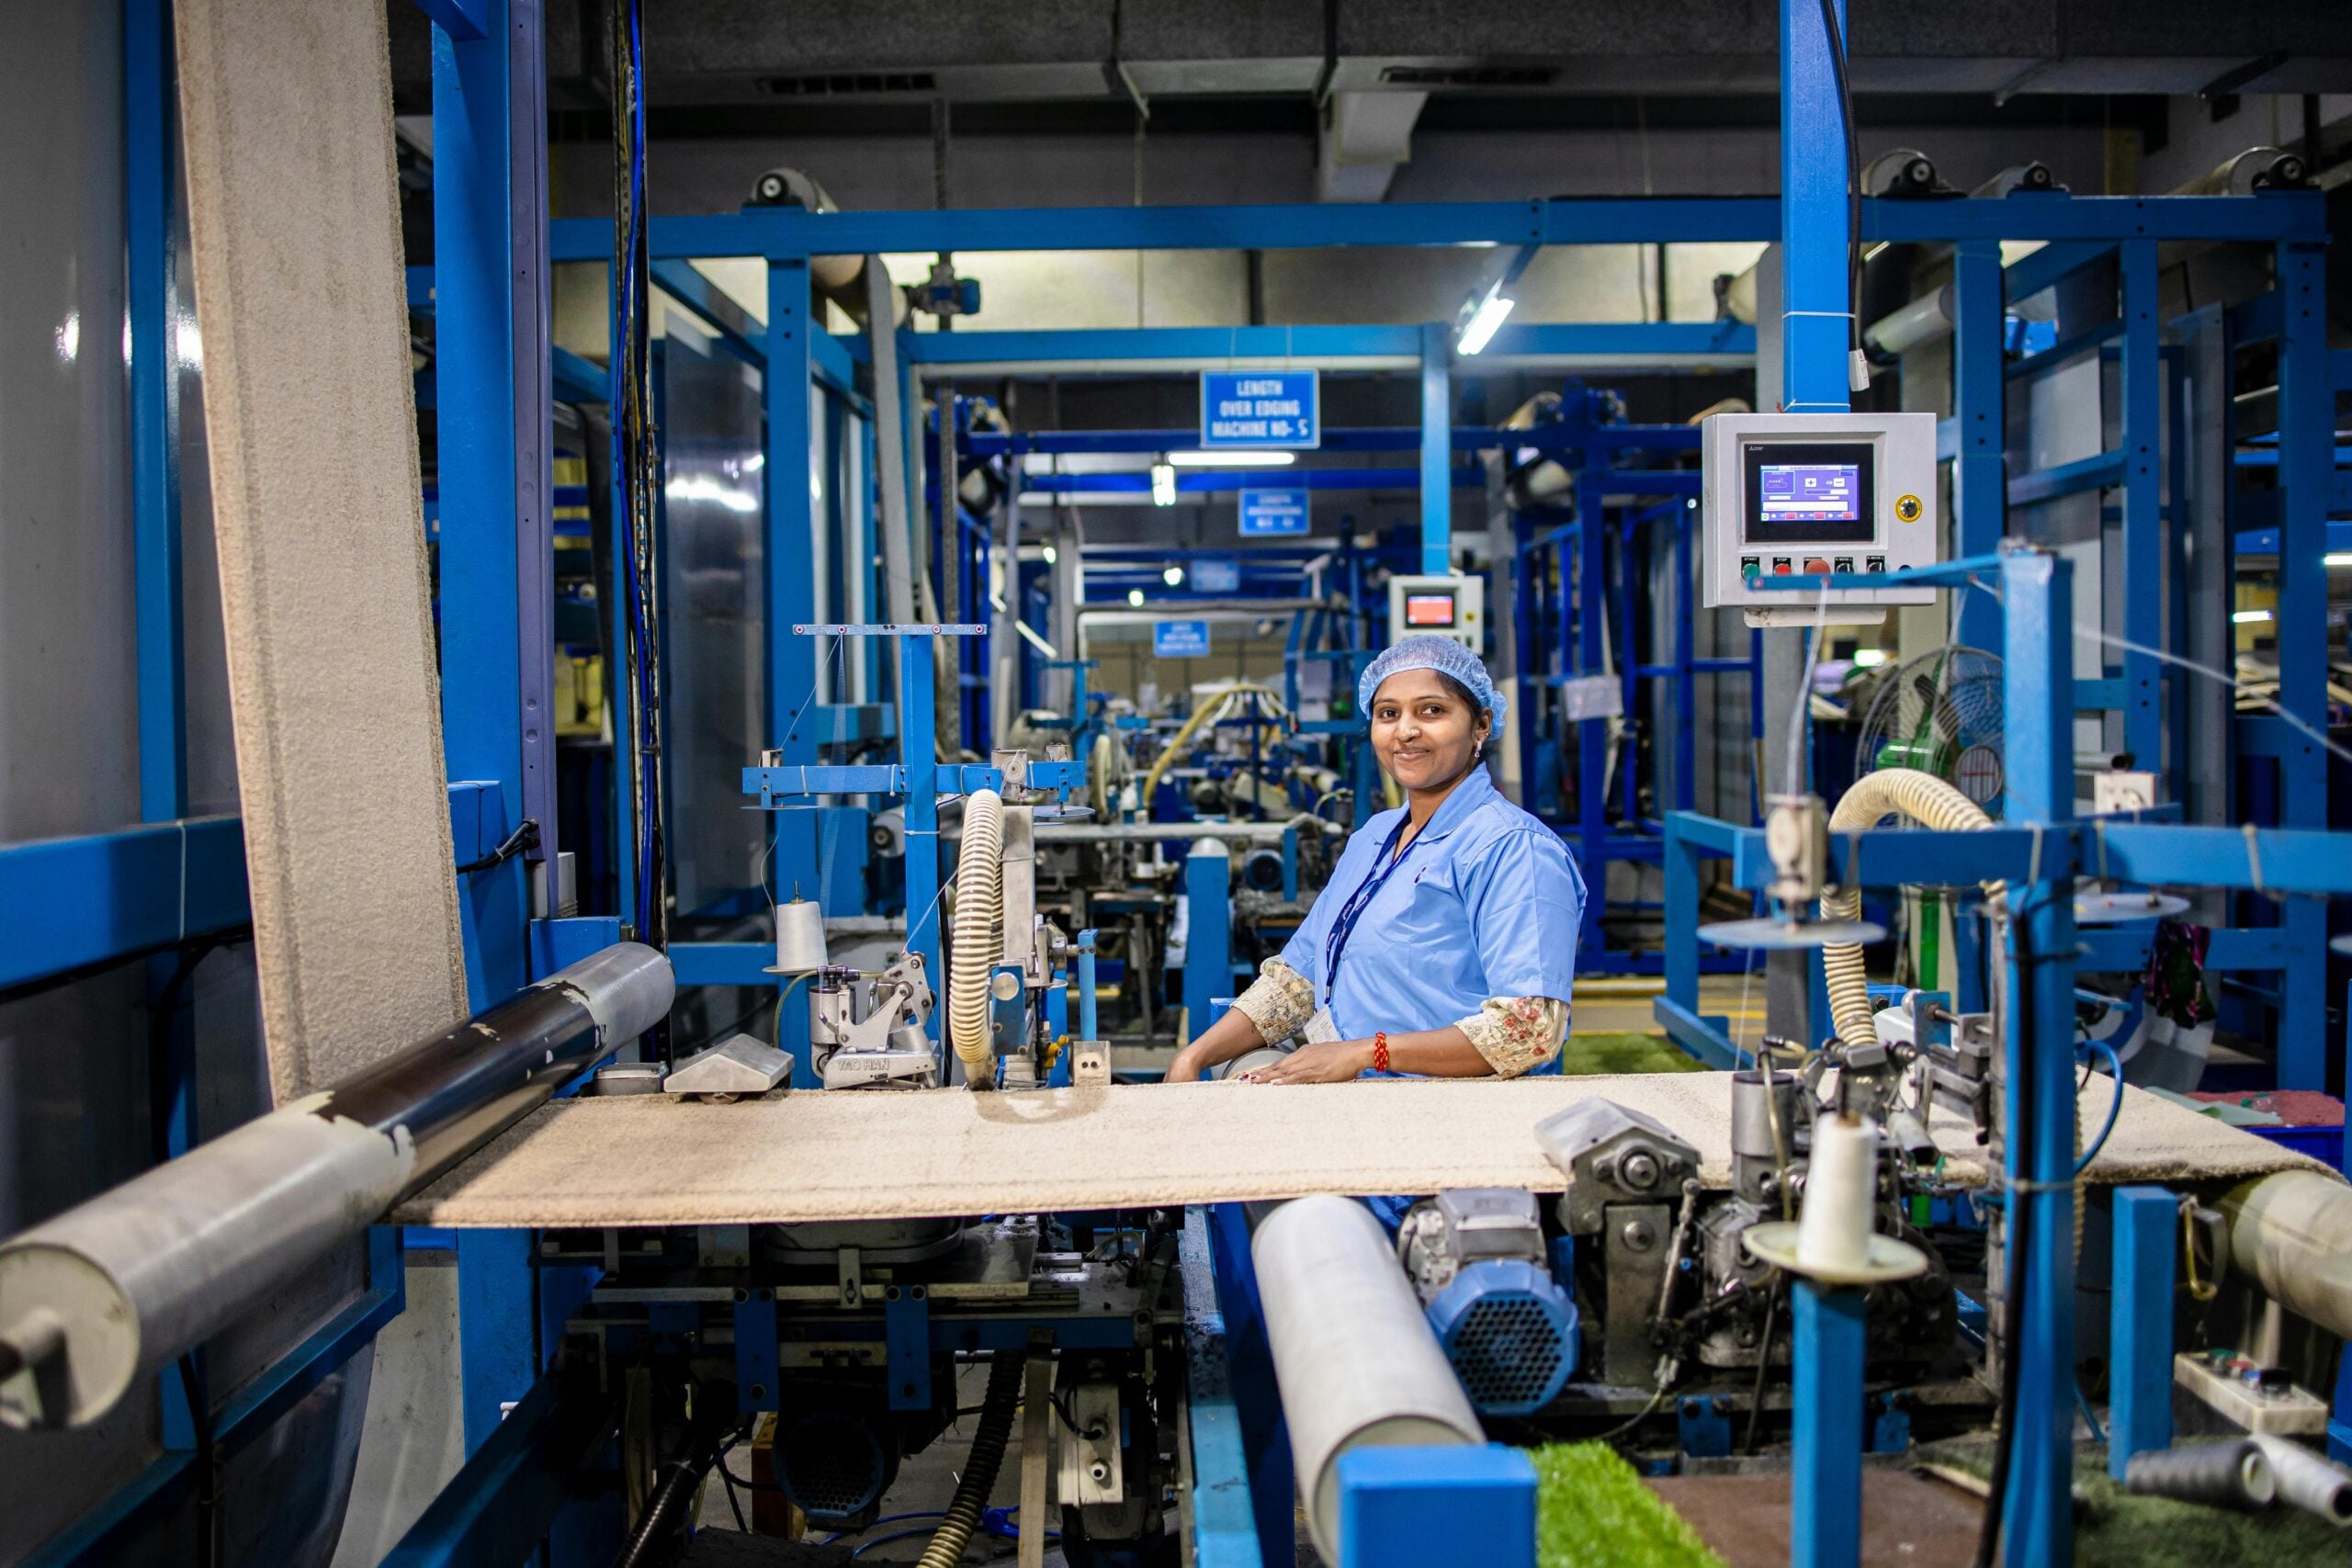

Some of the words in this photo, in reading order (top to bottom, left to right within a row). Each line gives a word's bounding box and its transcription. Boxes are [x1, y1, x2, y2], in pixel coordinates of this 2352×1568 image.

[1237, 380, 1283, 396] LENGTH
[1220, 400, 1252, 416] OVER
[1255, 400, 1300, 416] EDGING
[1213, 421, 1267, 436] MACHINE
[838, 1059, 861, 1071] YAO
[864, 1058, 889, 1071] HAN
